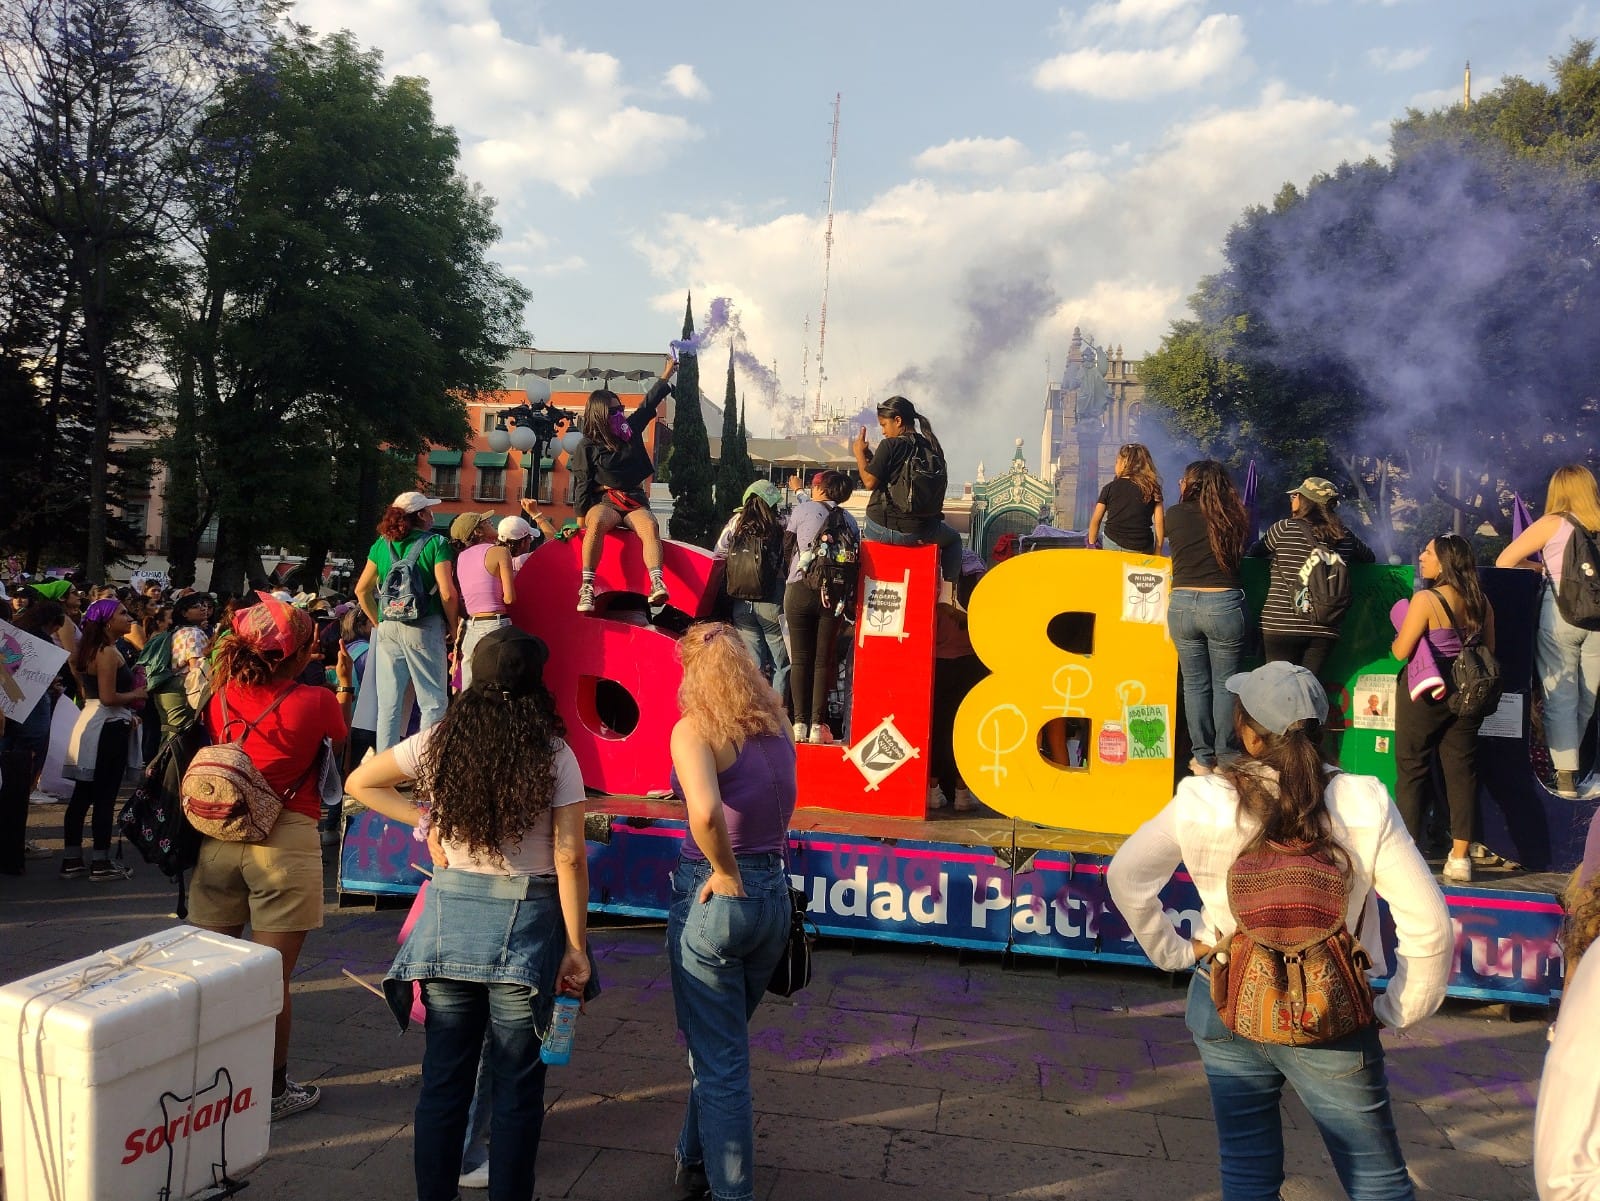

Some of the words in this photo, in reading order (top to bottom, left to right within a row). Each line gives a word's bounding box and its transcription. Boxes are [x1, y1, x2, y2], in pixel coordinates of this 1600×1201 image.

[1132, 745, 1166, 759] AMOR
[790, 865, 948, 925] udad
[121, 1087, 252, 1165] Soriana
